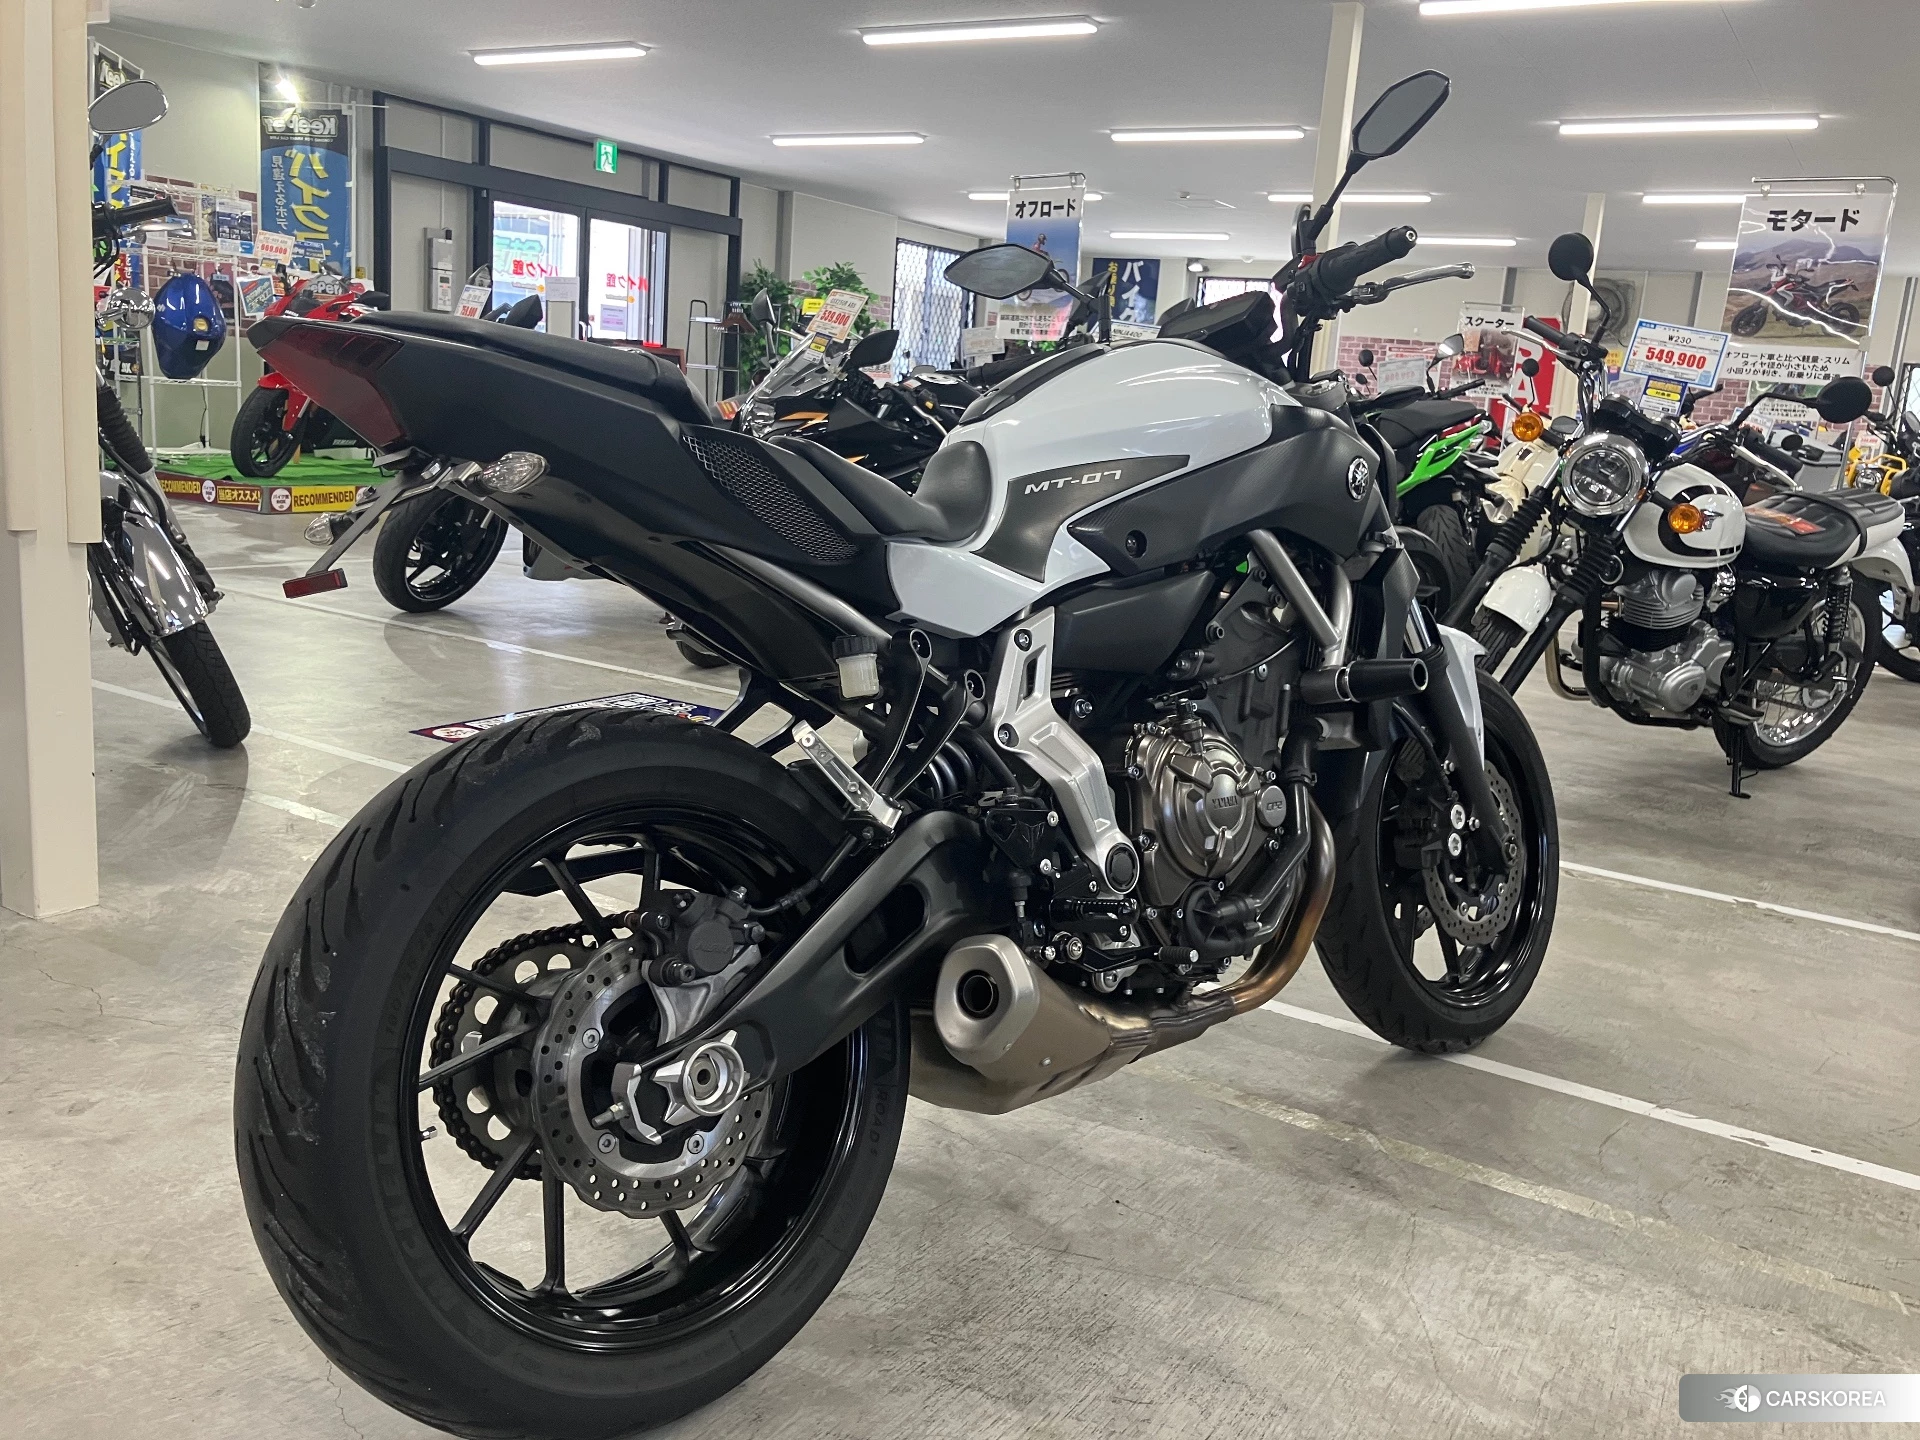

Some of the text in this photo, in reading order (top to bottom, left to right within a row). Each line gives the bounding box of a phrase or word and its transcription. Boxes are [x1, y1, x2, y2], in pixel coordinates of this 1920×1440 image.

[1015, 198, 1076, 218] オフロード
[1766, 208, 1860, 232] モタード
[820, 309, 850, 327] 539,900
[1464, 315, 1515, 328] スクーター
[1668, 334, 1692, 345] W230
[1645, 346, 1707, 370] 549,900
[1741, 360, 1829, 372] タイヤ径が小さいため
[160, 479, 201, 494] ECOMMENDED
[1024, 469, 1122, 495] MT-07
[293, 490, 354, 507] RECOMMENDED
[1211, 795, 1239, 809] YAMAHA
